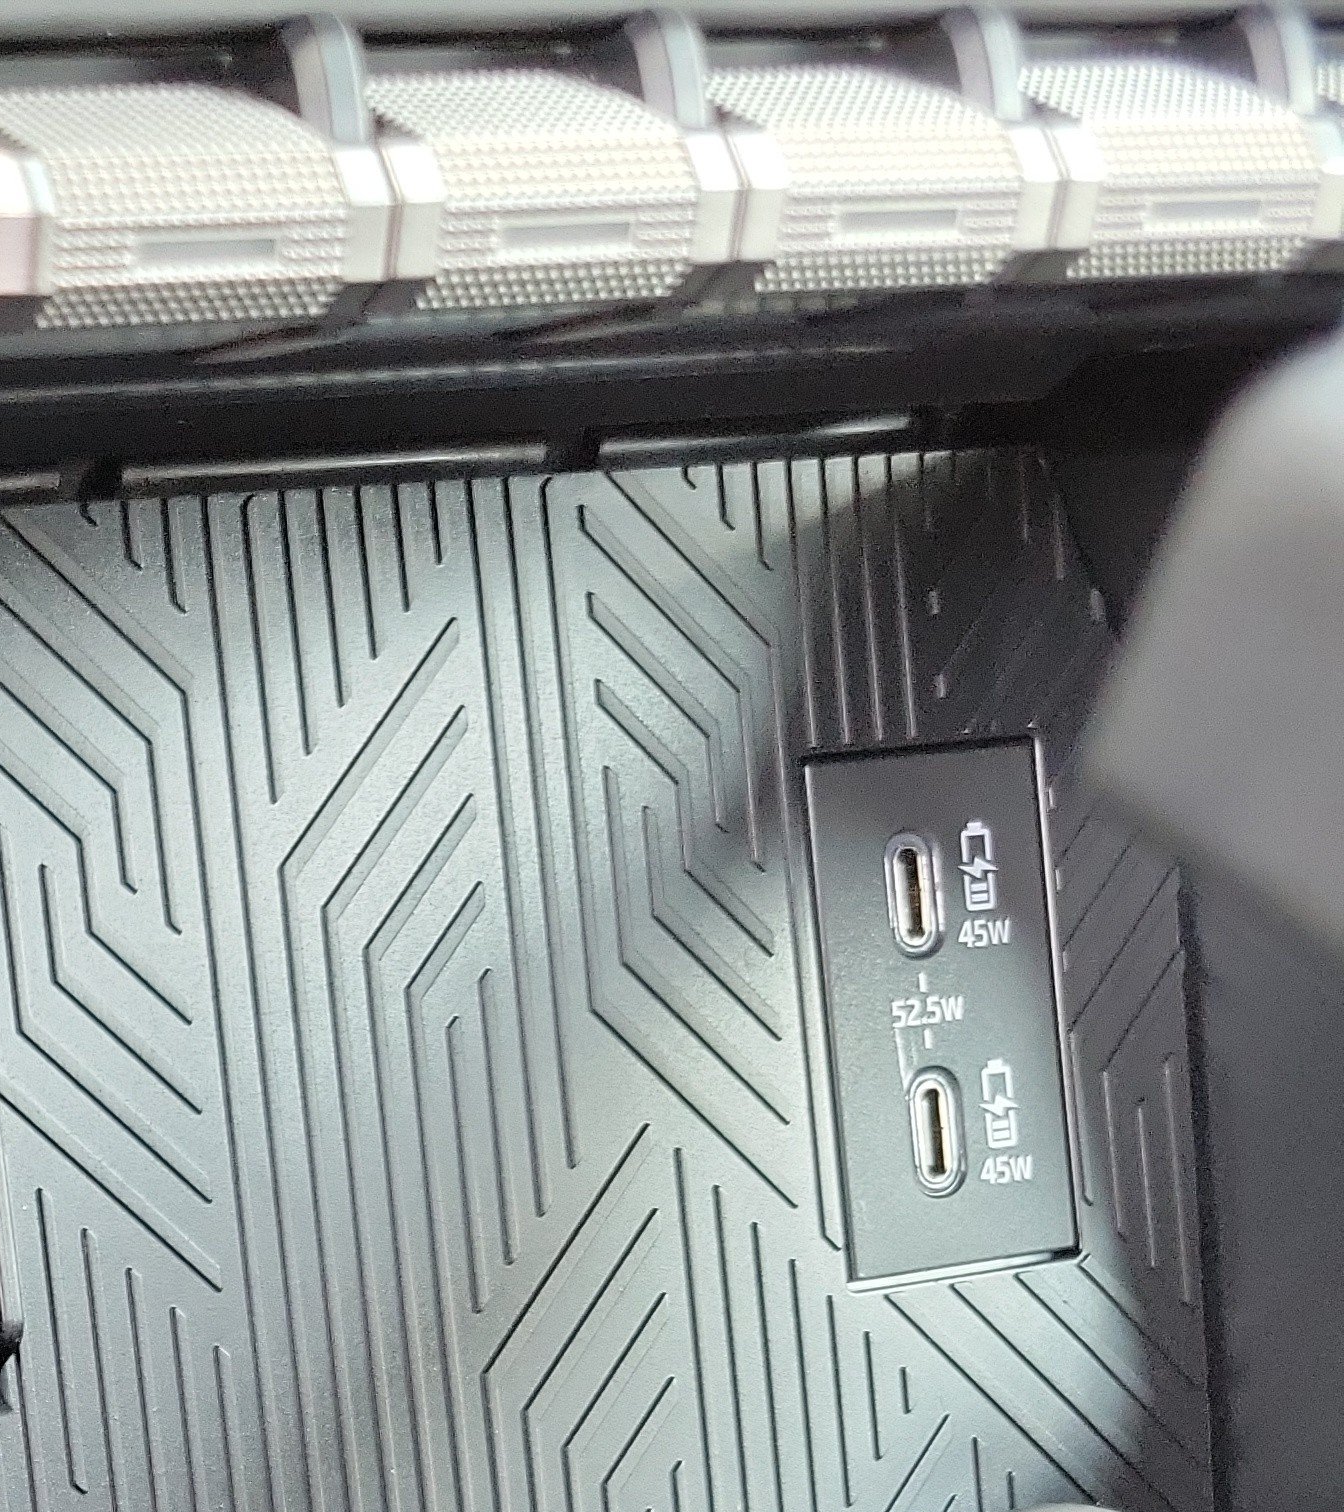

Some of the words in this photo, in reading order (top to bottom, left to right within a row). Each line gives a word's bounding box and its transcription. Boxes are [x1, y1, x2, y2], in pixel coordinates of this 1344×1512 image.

[957, 917, 1012, 948] 45W
[891, 994, 964, 1030] 52.5W
[980, 1154, 1033, 1184] 45W
